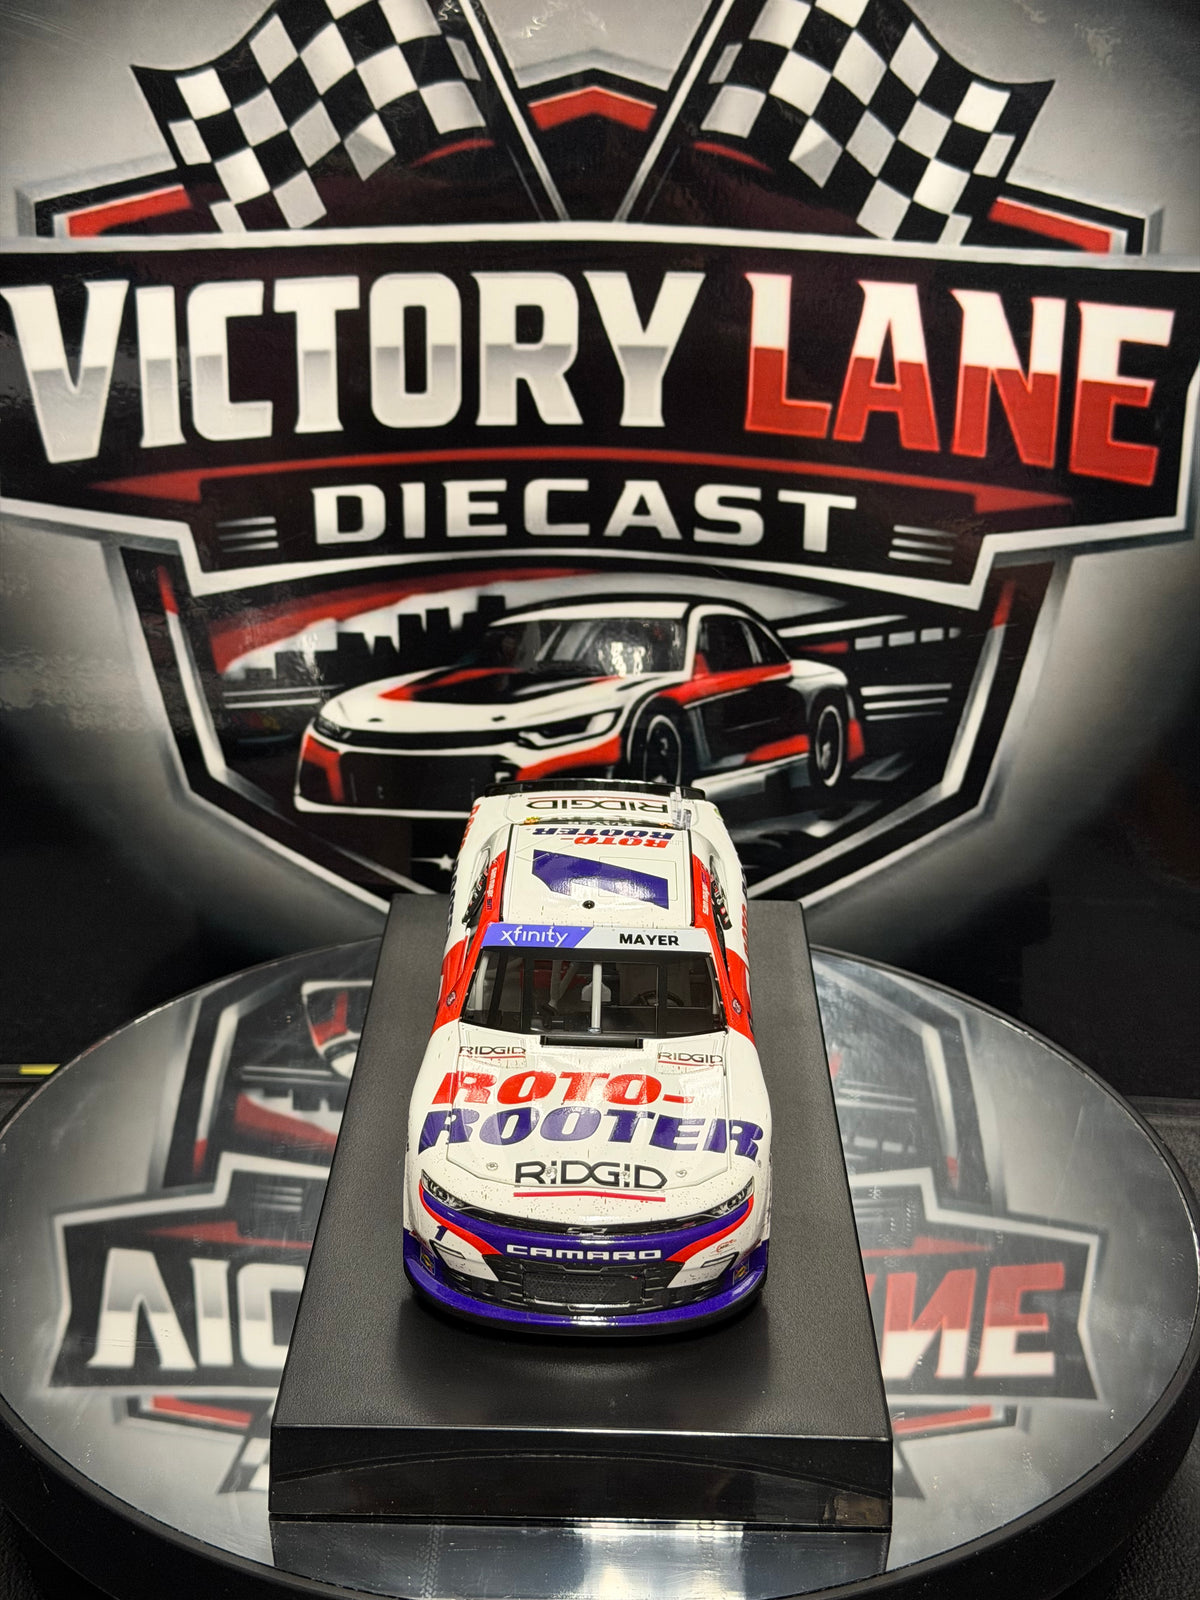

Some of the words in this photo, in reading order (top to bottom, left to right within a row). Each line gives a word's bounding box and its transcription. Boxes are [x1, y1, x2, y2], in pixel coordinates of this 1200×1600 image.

[0, 271, 706, 464] VICTORY
[743, 271, 1175, 486] LANE
[311, 477, 857, 553] DIECAST
[526, 799, 669, 814] RIDGID
[532, 827, 675, 841] ROOTER
[500, 924, 569, 947] xfinity
[618, 932, 680, 947] MAYER
[459, 1045, 526, 1056] RIDGID
[657, 1051, 723, 1064] RIDGID
[431, 1070, 696, 1105] ROTO-
[417, 1105, 764, 1162] ROOTER
[514, 1159, 668, 1190] RIDGID
[434, 1224, 449, 1242] 1
[505, 1243, 662, 1261] CAMARO
